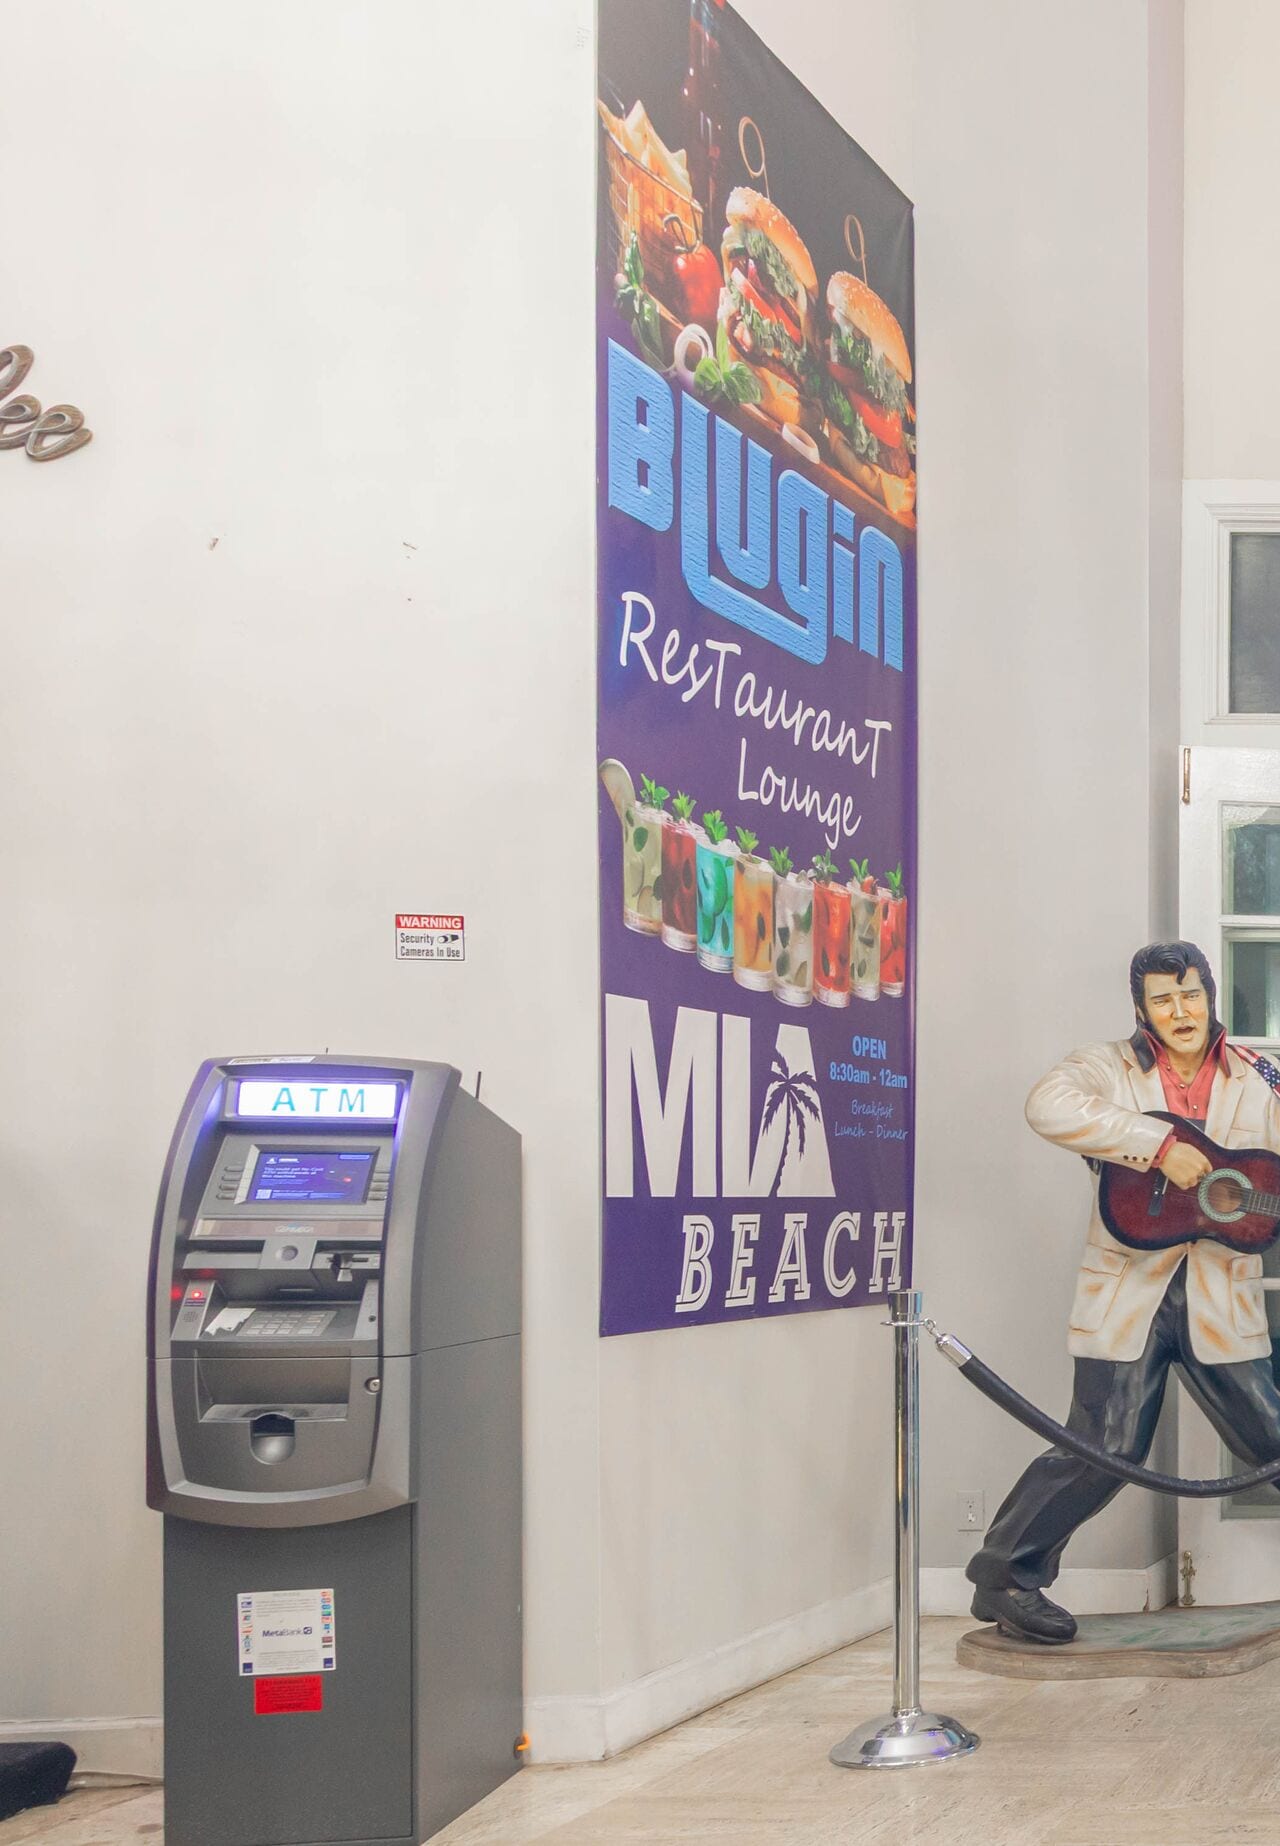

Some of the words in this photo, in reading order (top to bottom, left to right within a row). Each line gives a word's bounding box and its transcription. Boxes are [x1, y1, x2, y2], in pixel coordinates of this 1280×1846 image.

[737, 737, 862, 850] Lounge
[399, 916, 462, 929] WARNING
[400, 932, 435, 946] Security
[400, 946, 435, 957] Cameras
[437, 947, 445, 957] In
[446, 947, 461, 958] Use
[852, 1035, 887, 1060] OPEN
[829, 1061, 870, 1084] 8:30am
[879, 1068, 908, 1089] 12am
[272, 1087, 366, 1113] ATM
[604, 992, 837, 1198] MIA
[851, 1099, 894, 1121] Breakfast
[834, 1120, 866, 1137] Lunch
[876, 1124, 909, 1141] Dinner
[674, 1211, 907, 1313] BEACH
